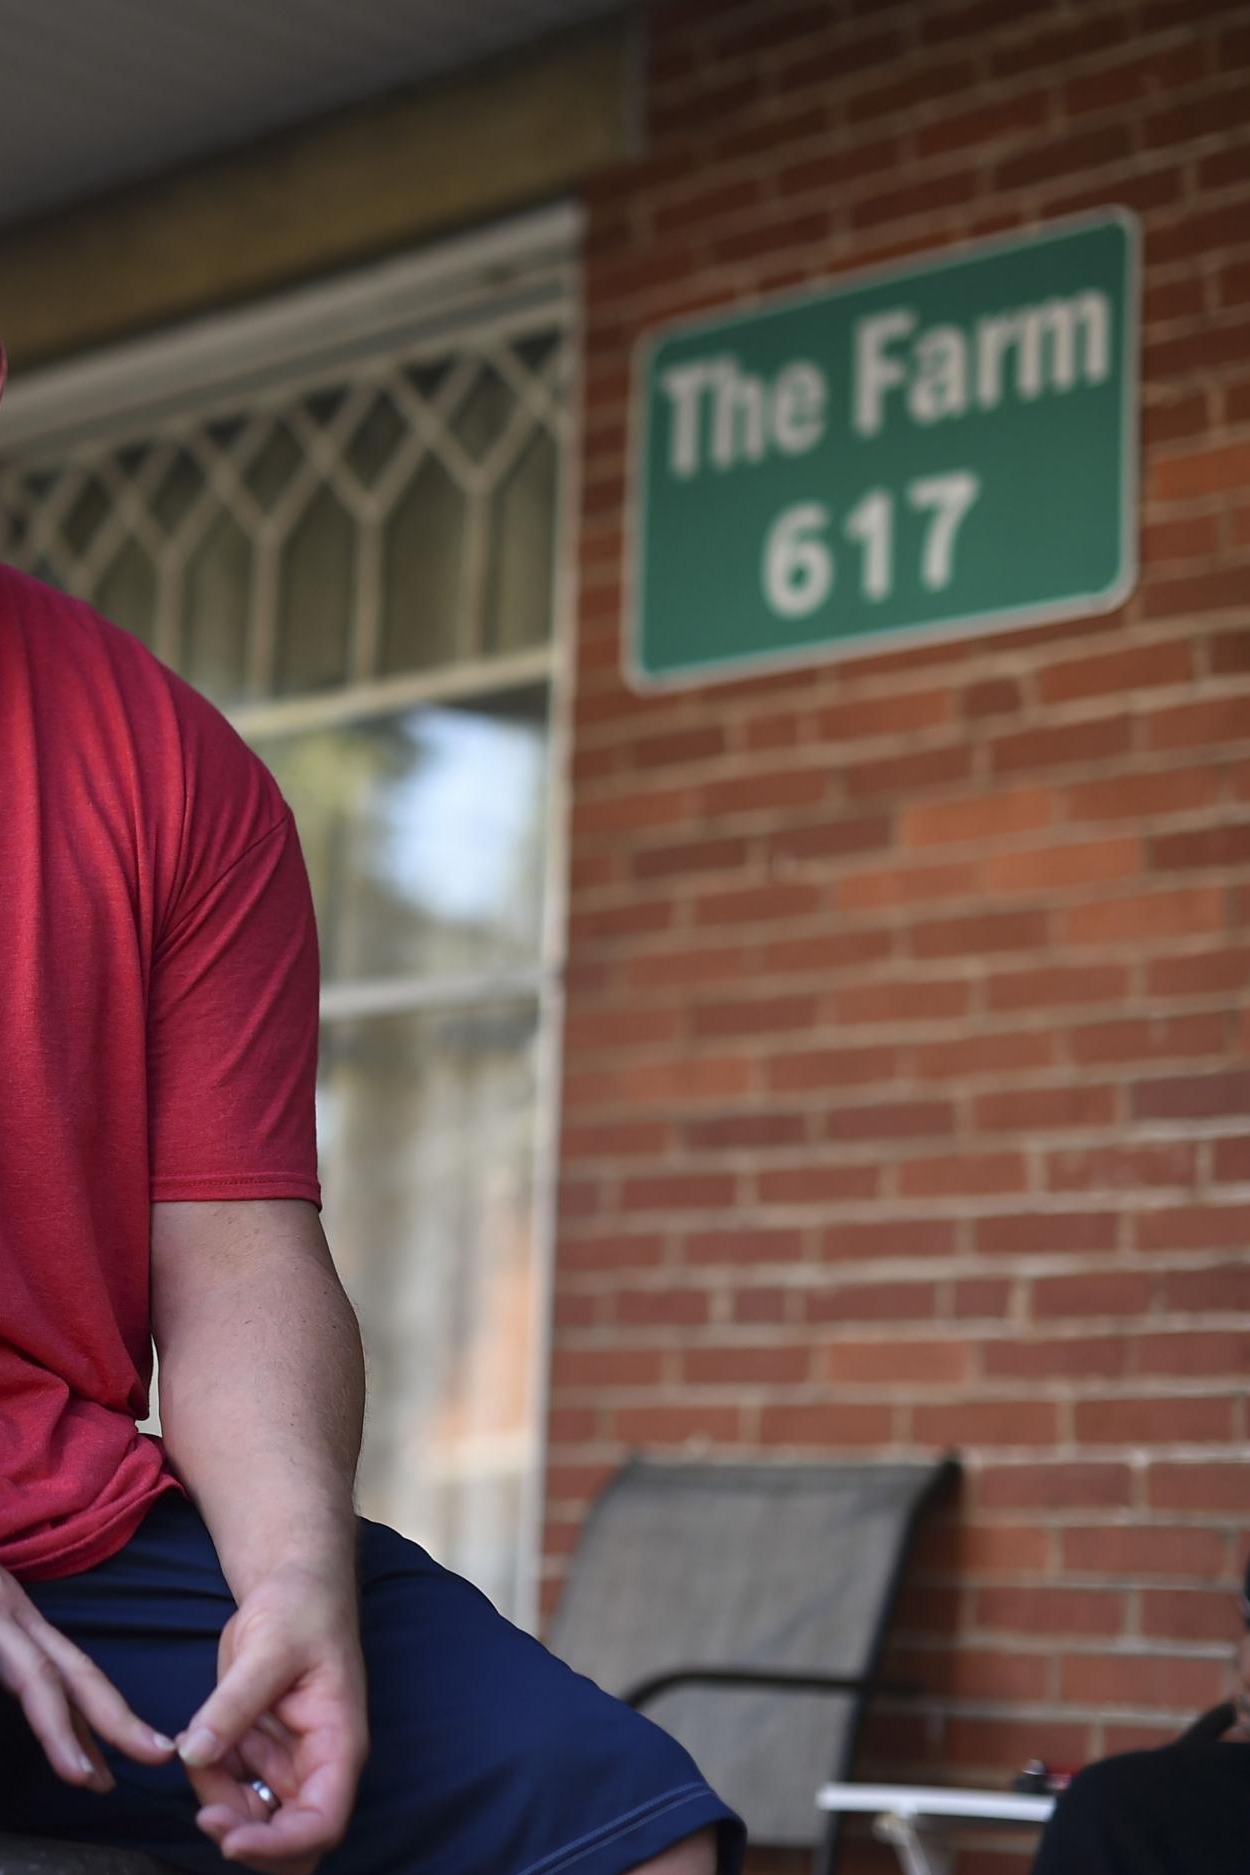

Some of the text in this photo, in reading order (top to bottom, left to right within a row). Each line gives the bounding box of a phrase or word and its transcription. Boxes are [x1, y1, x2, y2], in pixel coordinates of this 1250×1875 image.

[661, 290, 1111, 479] The Farm
[762, 471, 979, 619] 617
